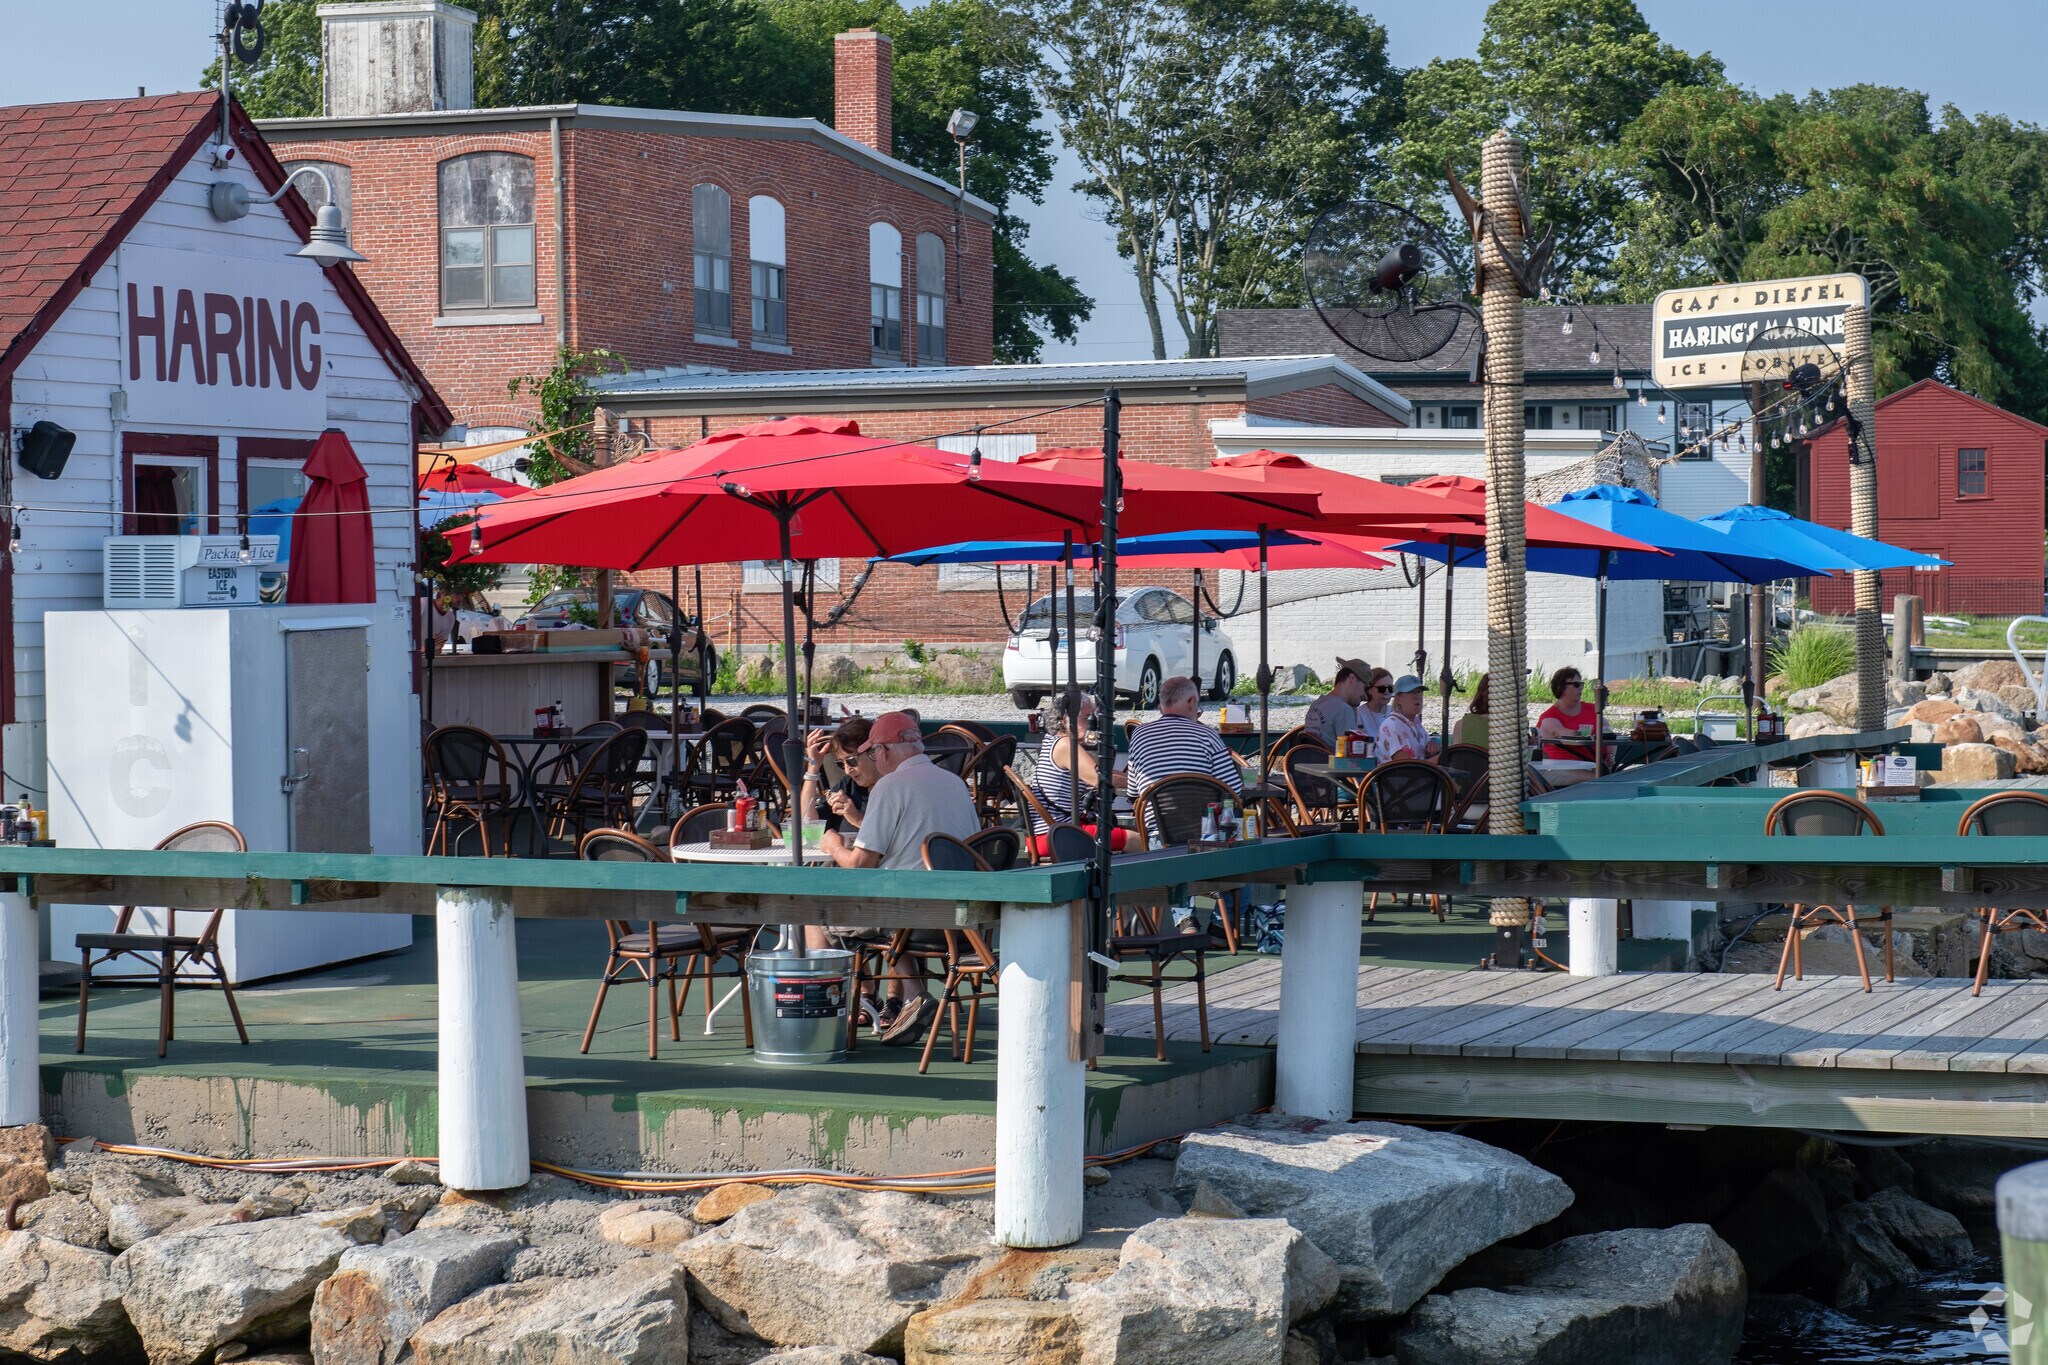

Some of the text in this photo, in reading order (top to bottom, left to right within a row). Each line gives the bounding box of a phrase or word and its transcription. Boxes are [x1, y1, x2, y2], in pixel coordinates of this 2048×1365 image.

[1671, 283, 1844, 314] GAS DIESEL
[127, 282, 321, 391] HARING
[1668, 313, 1845, 349] HARING'S MARINE
[1671, 362, 1707, 377] ICE
[204, 546, 275, 562] Packagd Ice
[208, 567, 237, 580] EASTERN
[216, 580, 228, 591] ICE
